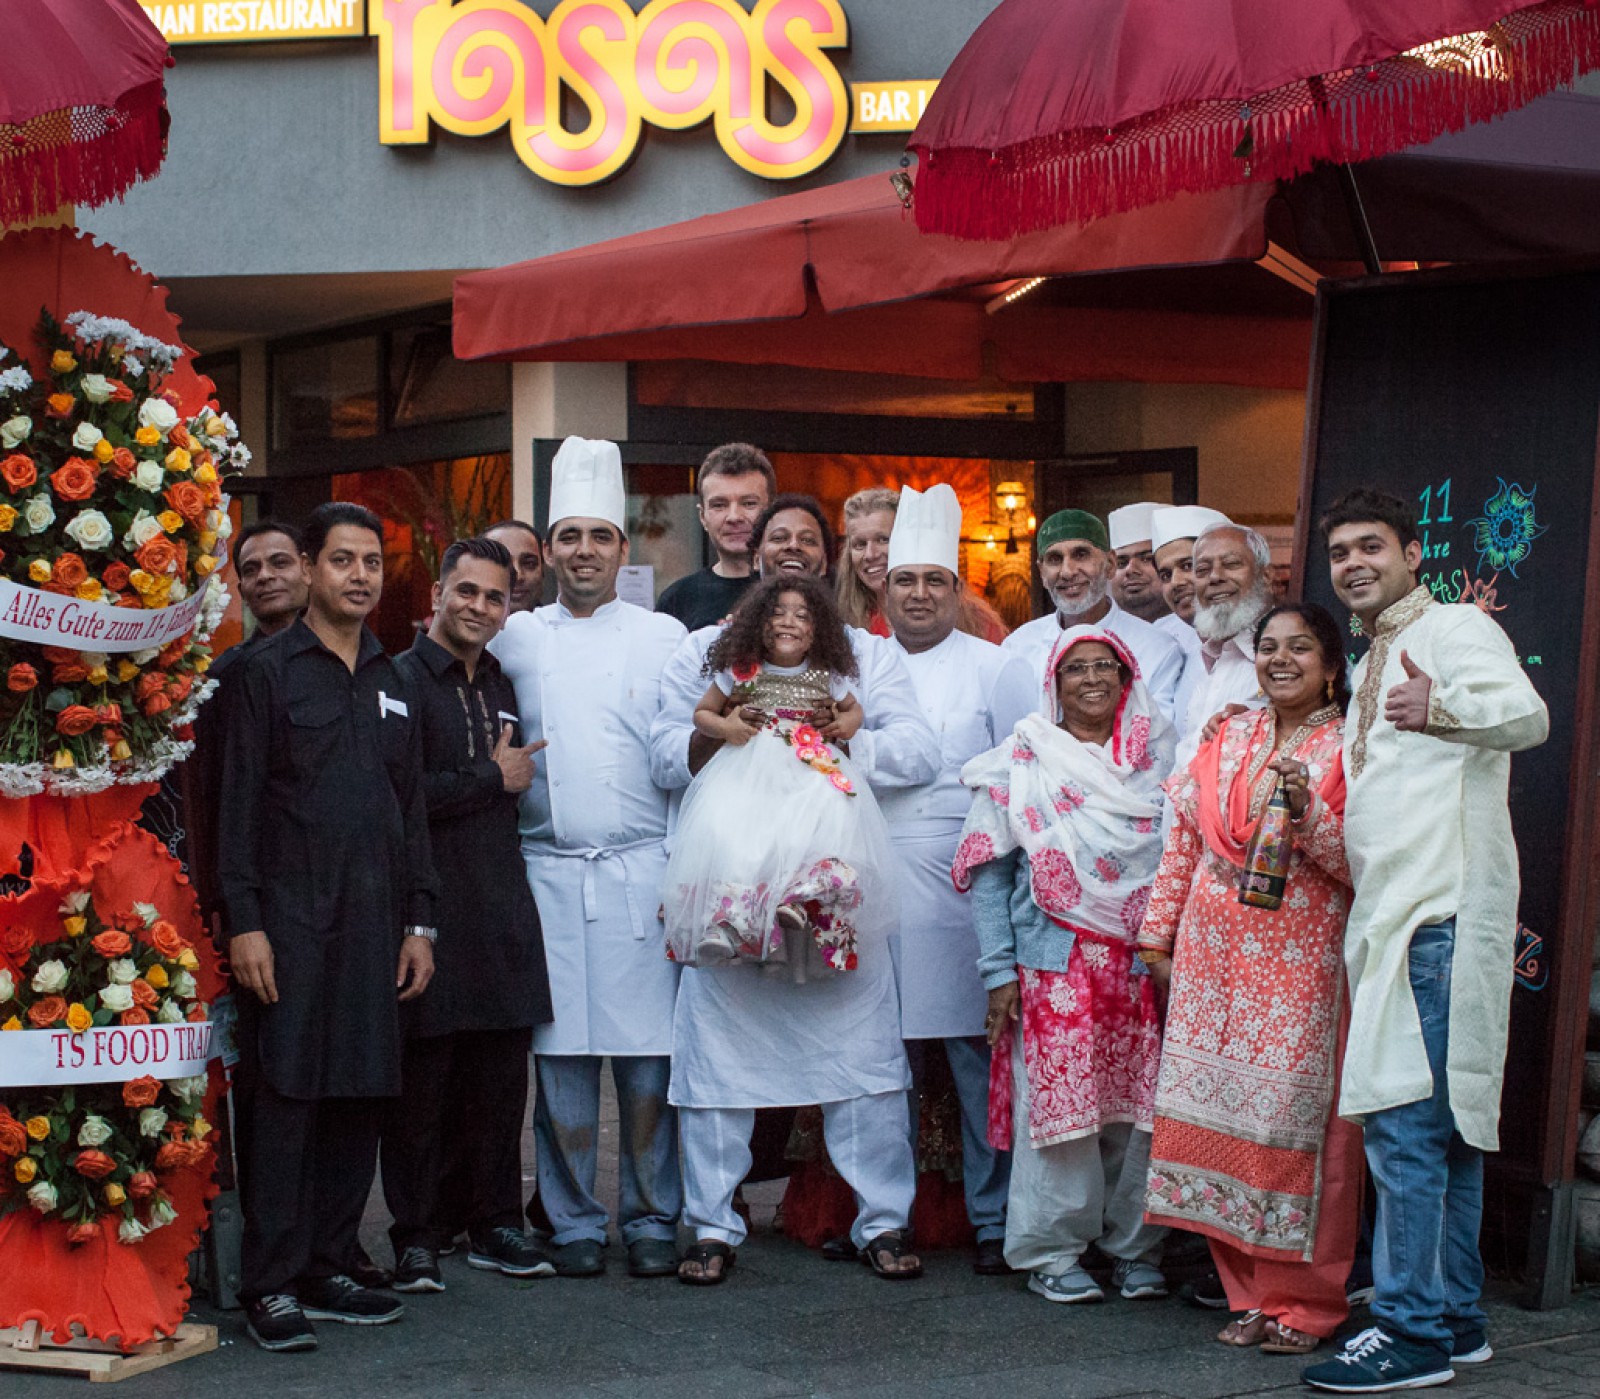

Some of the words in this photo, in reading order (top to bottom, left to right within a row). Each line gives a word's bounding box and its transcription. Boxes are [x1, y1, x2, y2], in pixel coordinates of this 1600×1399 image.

[203, 0, 358, 34] RESTAURANT
[860, 89, 912, 122] BAR
[1417, 477, 1453, 525] 11
[2, 590, 55, 630] Alles
[58, 602, 104, 639] Gute
[104, 621, 144, 641] zum
[51, 1032, 85, 1068] TS
[93, 1028, 169, 1066] FOOD
